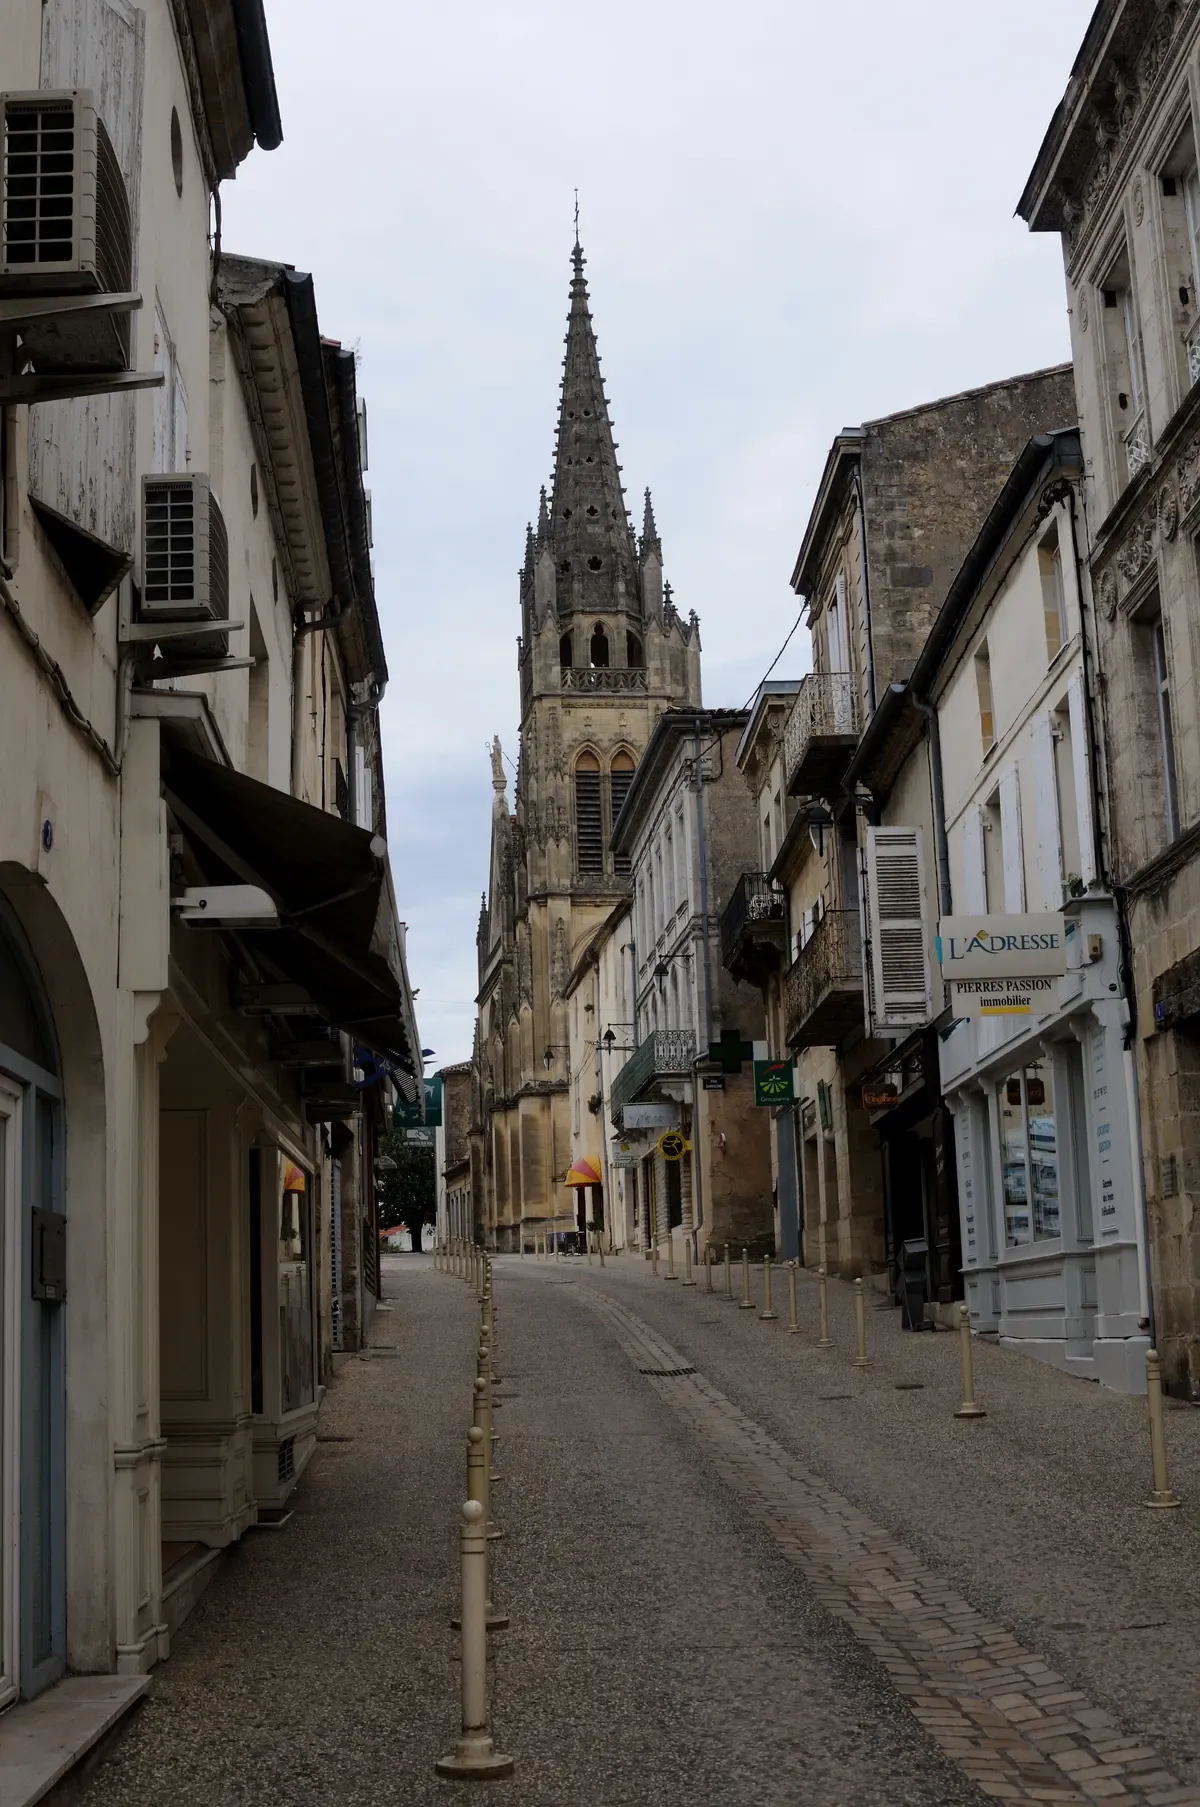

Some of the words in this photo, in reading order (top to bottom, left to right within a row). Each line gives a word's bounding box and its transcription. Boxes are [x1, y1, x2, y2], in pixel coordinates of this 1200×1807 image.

[948, 934, 1060, 960] L'ADRESSE
[956, 980, 1004, 994] PIERRES
[1006, 979, 1052, 992] PASSION
[980, 995, 1031, 1007] immobilier
